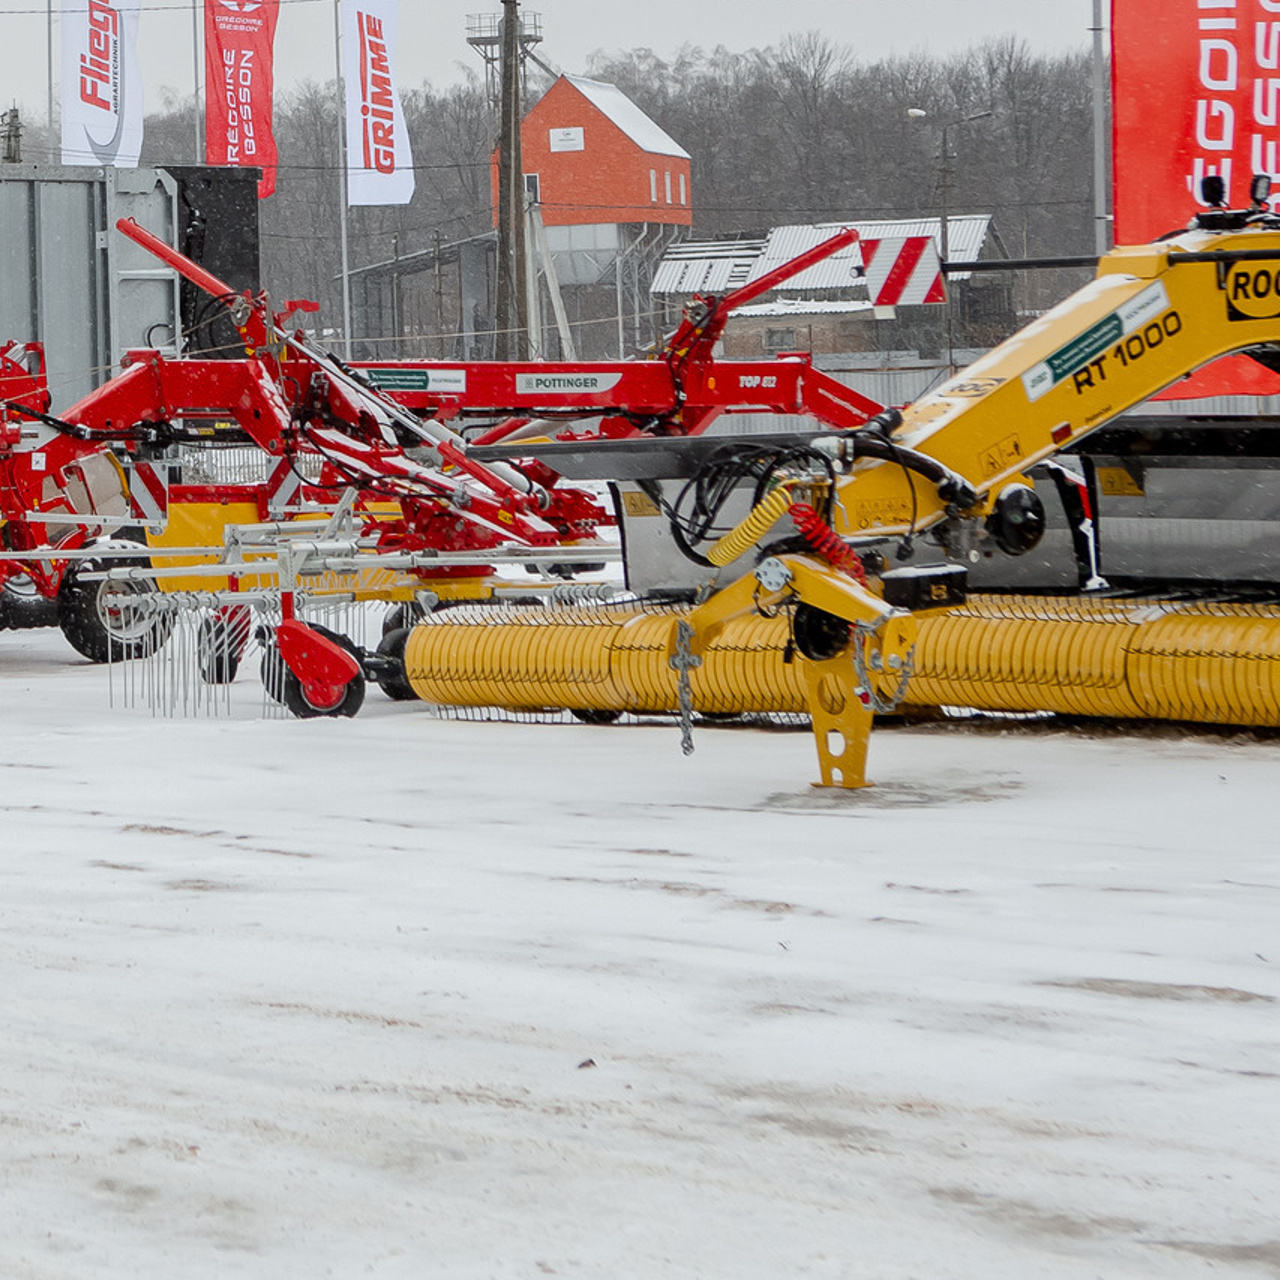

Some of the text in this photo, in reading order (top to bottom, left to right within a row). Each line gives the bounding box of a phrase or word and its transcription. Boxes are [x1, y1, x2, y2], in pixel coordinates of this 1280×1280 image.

[223, 48, 239, 167] RÉGOIRE
[239, 50, 256, 155] BESSON
[362, 13, 395, 175] GRIMME
[739, 375, 761, 388] TOP
[1072, 354, 1107, 395] RT
[1114, 311, 1182, 367] 1000
